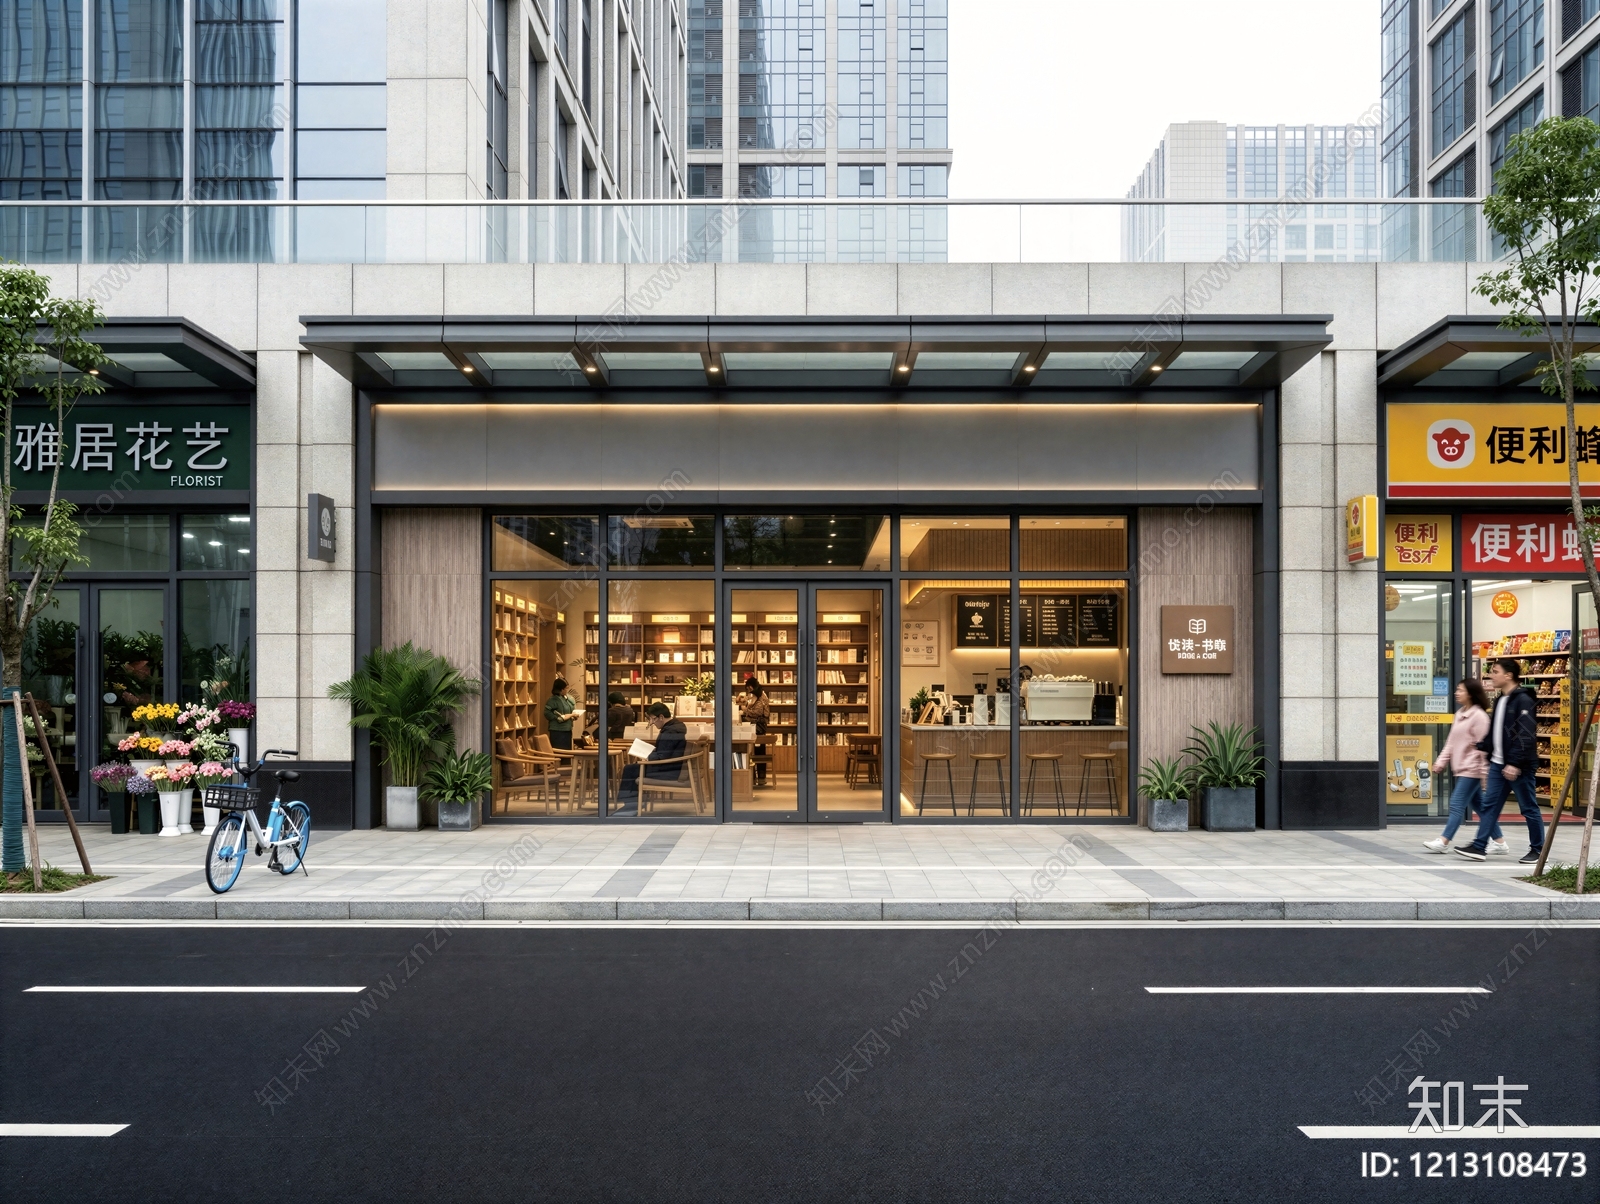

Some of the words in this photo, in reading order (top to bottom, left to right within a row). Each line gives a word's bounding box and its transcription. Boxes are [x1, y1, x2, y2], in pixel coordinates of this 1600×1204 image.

[14, 421, 230, 472] 雅居花艺
[170, 475, 224, 487] FLORIST
[1394, 523, 1438, 543] 便利
